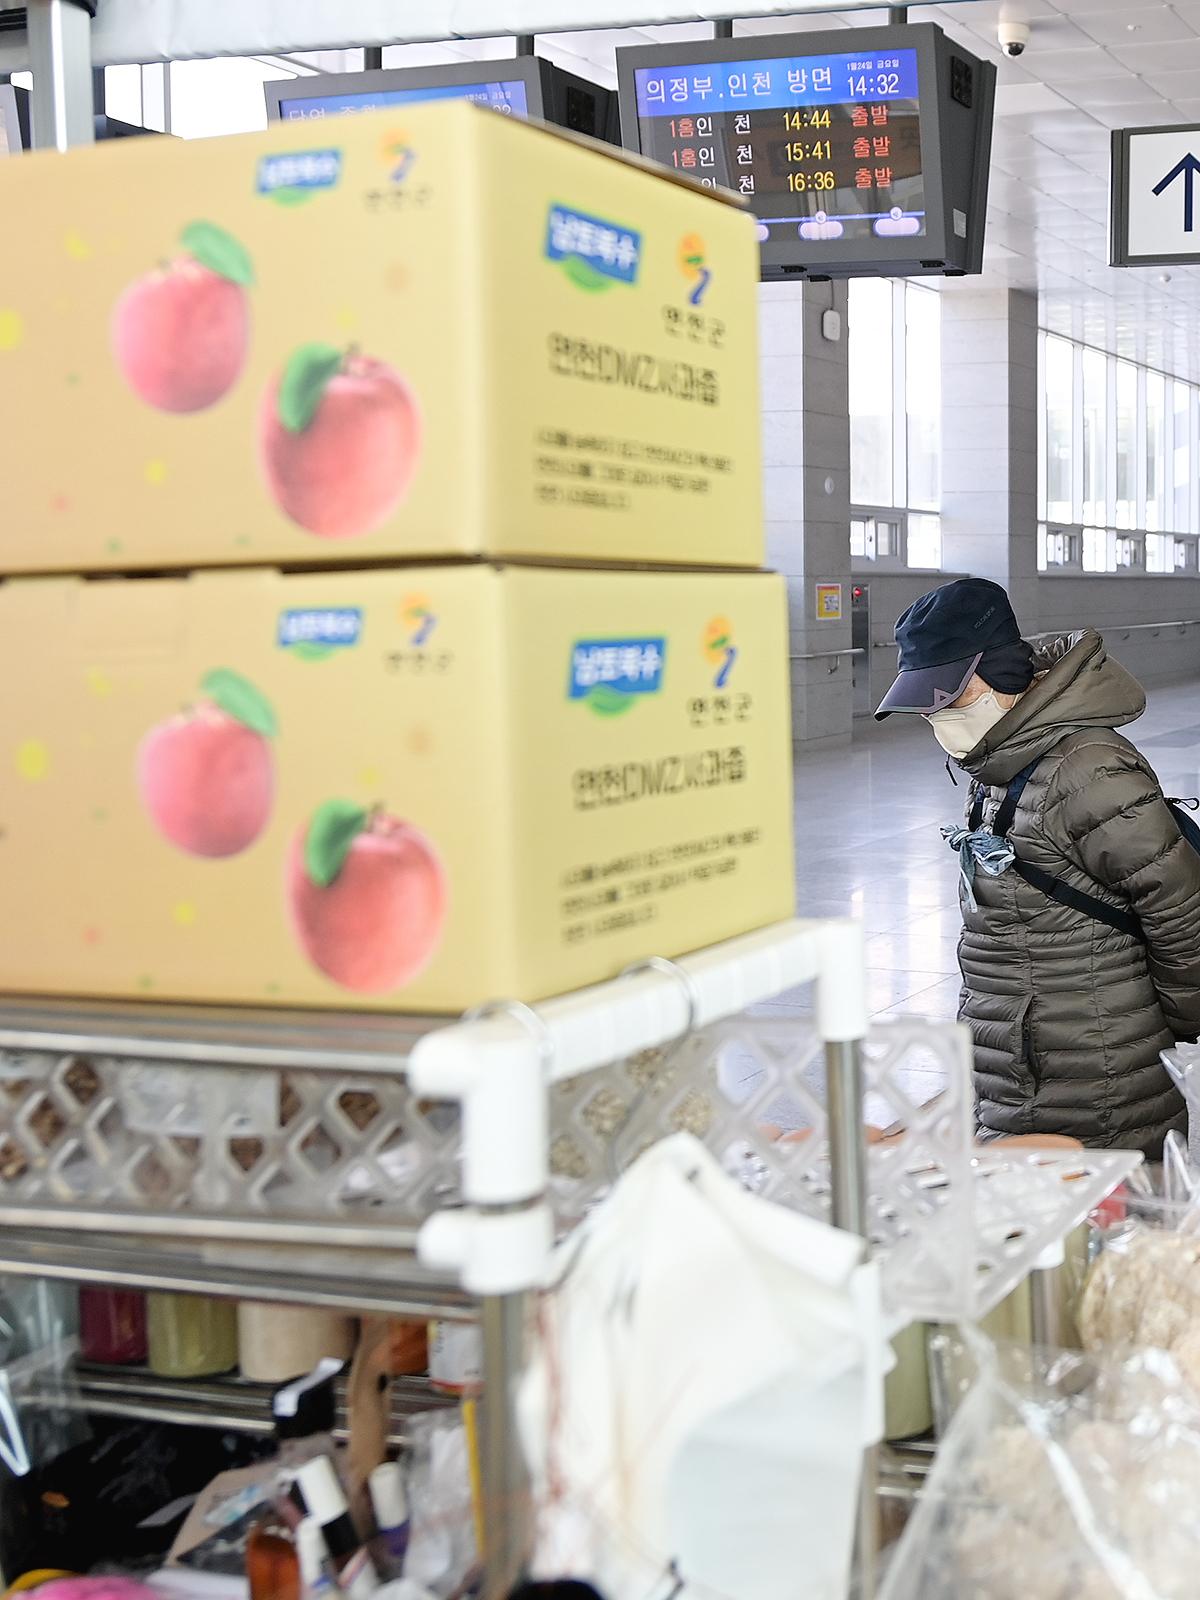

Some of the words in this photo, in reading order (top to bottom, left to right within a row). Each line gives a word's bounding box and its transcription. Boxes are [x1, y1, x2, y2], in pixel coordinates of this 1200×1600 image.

[877, 59, 899, 69] 금요일
[787, 67, 833, 92] 방면
[848, 73, 900, 97] 14:32
[783, 109, 832, 131] 14:44
[852, 104, 889, 127] 출발
[785, 140, 833, 162] 15:41
[853, 136, 891, 158] 출발
[787, 170, 835, 192] 16:36
[854, 167, 892, 189] 출발
